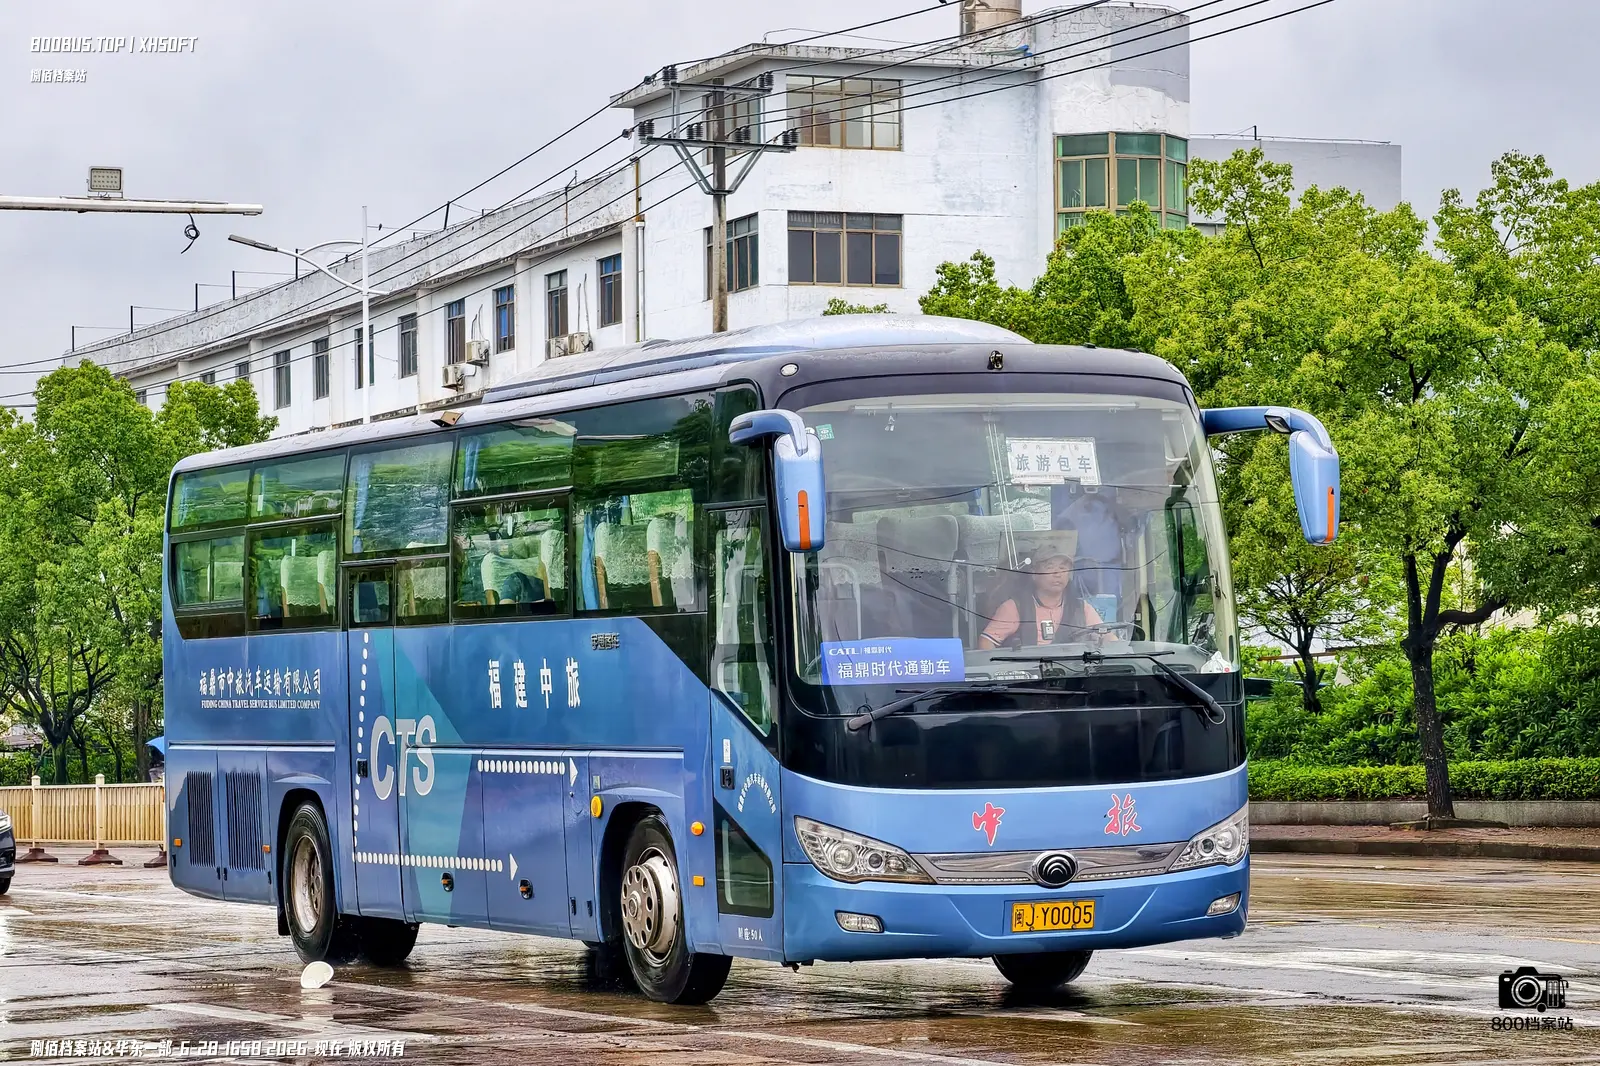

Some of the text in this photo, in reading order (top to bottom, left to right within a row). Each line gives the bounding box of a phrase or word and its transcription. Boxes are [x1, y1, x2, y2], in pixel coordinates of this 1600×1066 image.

[1015, 453, 1093, 474] 旅游包车
[828, 647, 860, 656] CATL
[863, 646, 892, 655] 福鼎时代
[837, 659, 951, 679] 福鼎时代通勤车
[488, 656, 581, 709] 福建中旅
[218, 699, 232, 709] CHINA
[232, 699, 249, 709] TRAVEL
[249, 699, 268, 709] SERVICE
[268, 699, 278, 709] BUS
[278, 699, 296, 709] LIMITED
[297, 699, 320, 709] COMPANY
[370, 714, 437, 801] CTS
